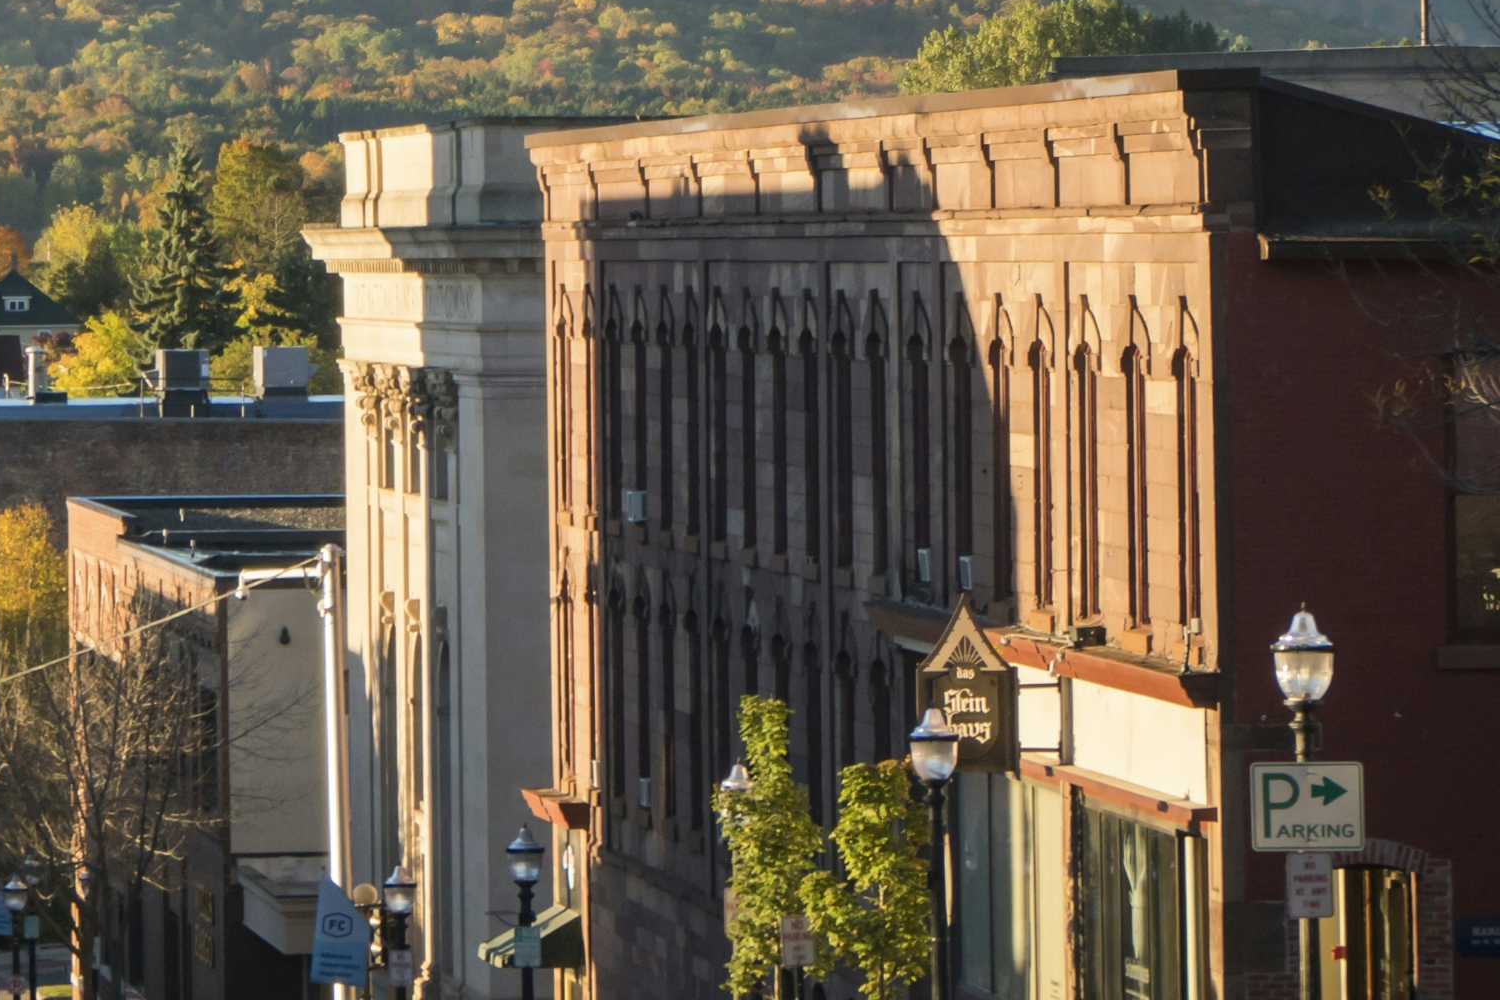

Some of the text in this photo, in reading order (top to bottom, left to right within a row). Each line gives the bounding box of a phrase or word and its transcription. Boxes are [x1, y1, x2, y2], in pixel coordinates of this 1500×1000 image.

[956, 666, 975, 680] das
[943, 688, 991, 714] Stein
[1303, 861, 1317, 870] NO
[328, 919, 347, 932] FC
